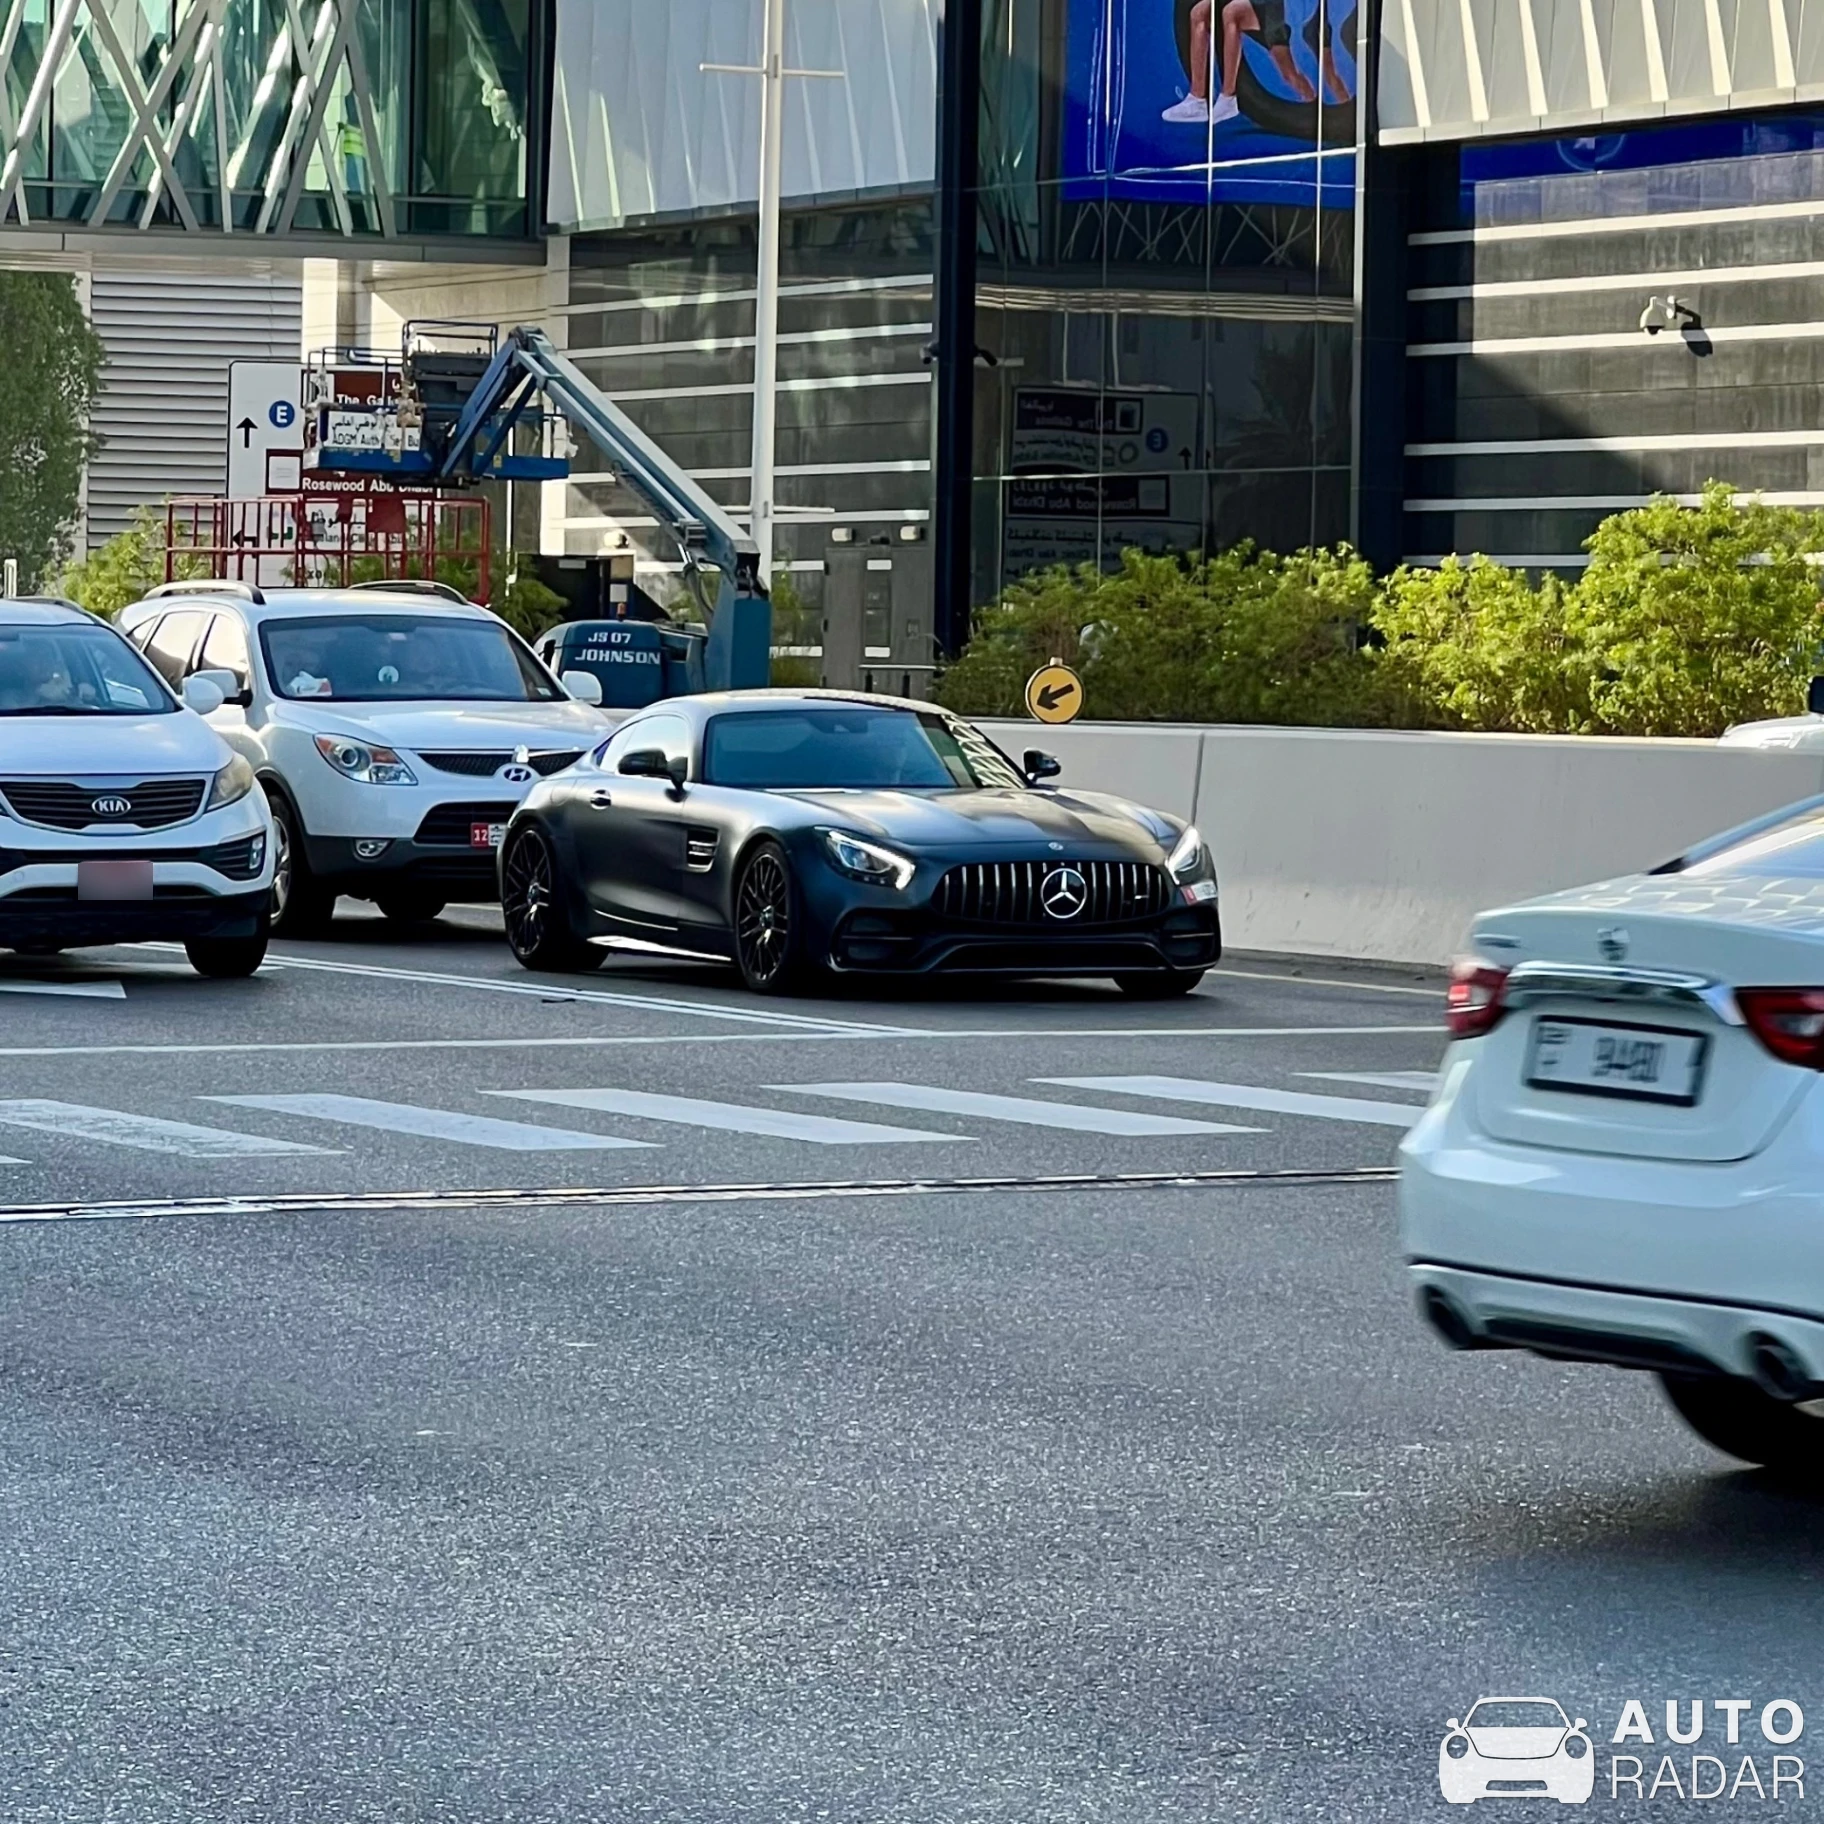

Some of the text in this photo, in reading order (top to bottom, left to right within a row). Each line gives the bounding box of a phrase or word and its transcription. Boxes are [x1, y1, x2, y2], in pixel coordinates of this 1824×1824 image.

[276, 405, 288, 423] E
[302, 477, 364, 491] Rosewood
[369, 478, 394, 493] Abu
[588, 632, 631, 644] JS 07
[575, 649, 660, 664] JOHNSON
[99, 800, 124, 812] KIA
[474, 829, 488, 841] 12
